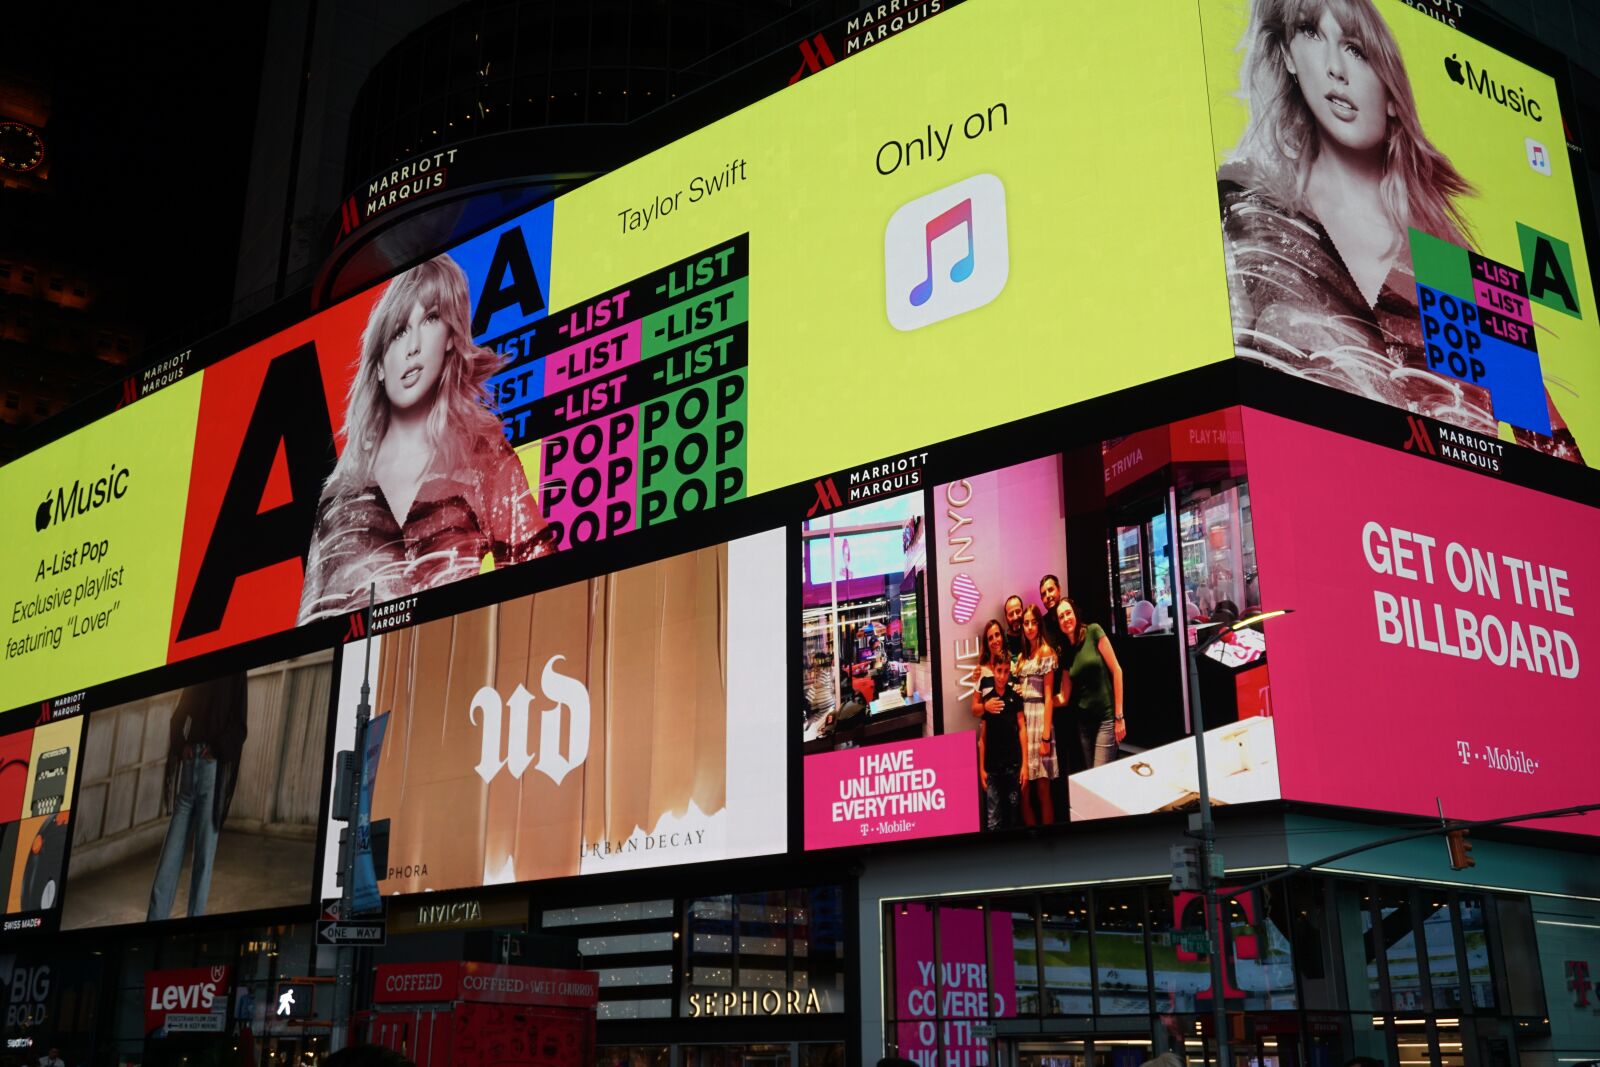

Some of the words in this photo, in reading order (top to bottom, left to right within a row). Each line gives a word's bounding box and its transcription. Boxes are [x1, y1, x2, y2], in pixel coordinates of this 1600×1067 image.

[847, 0, 919, 34] MARRI
[847, 0, 941, 54] MARQUIS
[1463, 60, 1543, 123] Music
[876, 124, 953, 175] Only
[963, 102, 1008, 139] on
[368, 149, 458, 198] MARRIOTT
[366, 173, 443, 217] MARQUIS
[617, 189, 682, 234] Taylor
[688, 158, 748, 203] Swift
[473, 225, 546, 338] A
[559, 290, 631, 337] -LIST
[655, 247, 735, 299] -LIST
[1476, 262, 1520, 291] -LIST
[1529, 236, 1579, 314] A
[1420, 286, 1477, 326] POP
[1480, 288, 1524, 318] -LIST
[496, 329, 536, 366] IST
[556, 333, 629, 381] -LIST
[654, 291, 735, 342] -LIST
[1424, 316, 1481, 354] POP
[1485, 315, 1529, 345] -LIST
[144, 350, 192, 381] MARRIOTT
[553, 375, 628, 423] -LIST
[652, 335, 735, 387] -LIST
[1428, 344, 1486, 383] POP
[141, 367, 184, 396] MARQUIS
[494, 370, 533, 405] IST
[545, 413, 634, 475] POP
[644, 374, 745, 443] POP
[1189, 429, 1211, 444] PLAY
[1439, 427, 1504, 457] MARRIOTT
[543, 457, 632, 518] POP
[642, 420, 744, 488] POP
[850, 452, 929, 484] MARRIOTT
[1111, 448, 1143, 477] TRIVIA
[1441, 444, 1499, 471] MARQUIS
[53, 463, 130, 526] Music
[175, 340, 338, 643] A
[641, 467, 743, 528] POP
[850, 471, 919, 501] MARQUIS
[946, 479, 975, 565] NYC
[35, 548, 77, 583] A-List
[80, 538, 109, 567] Pop
[1361, 521, 1436, 584] GET
[1445, 541, 1501, 600] ON
[1502, 555, 1574, 616] THE
[11, 582, 72, 624] Exclusive
[74, 565, 125, 606] playlist
[5, 624, 62, 660] featuring
[1373, 590, 1580, 679] BILLBOARD
[955, 636, 980, 701] WE
[53, 703, 81, 719] MARQUIS
[54, 692, 86, 708] MARRIOTT
[860, 755, 865, 776] I
[866, 749, 914, 775] HAVE
[839, 768, 936, 800] UNLIMITED
[832, 788, 946, 822] EVERYTHING
[580, 837, 638, 860] URBAN
[644, 829, 705, 850] DECAY
[388, 864, 428, 880] PHORA
[3, 920, 21, 931] SWISS
[21, 917, 37, 928] MADE
[418, 900, 482, 925] INVICTA
[328, 927, 347, 938] ONE
[357, 928, 377, 937] WAY
[10, 964, 51, 1003] BIG
[386, 973, 442, 992] COFFEED
[464, 975, 524, 993] COFFEED
[530, 980, 557, 994] SWEET
[558, 982, 594, 997] CHURROS
[7, 1004, 46, 1026] BOLD
[689, 988, 821, 1018] SEPHORA
[908, 989, 1005, 1017] COVERED
